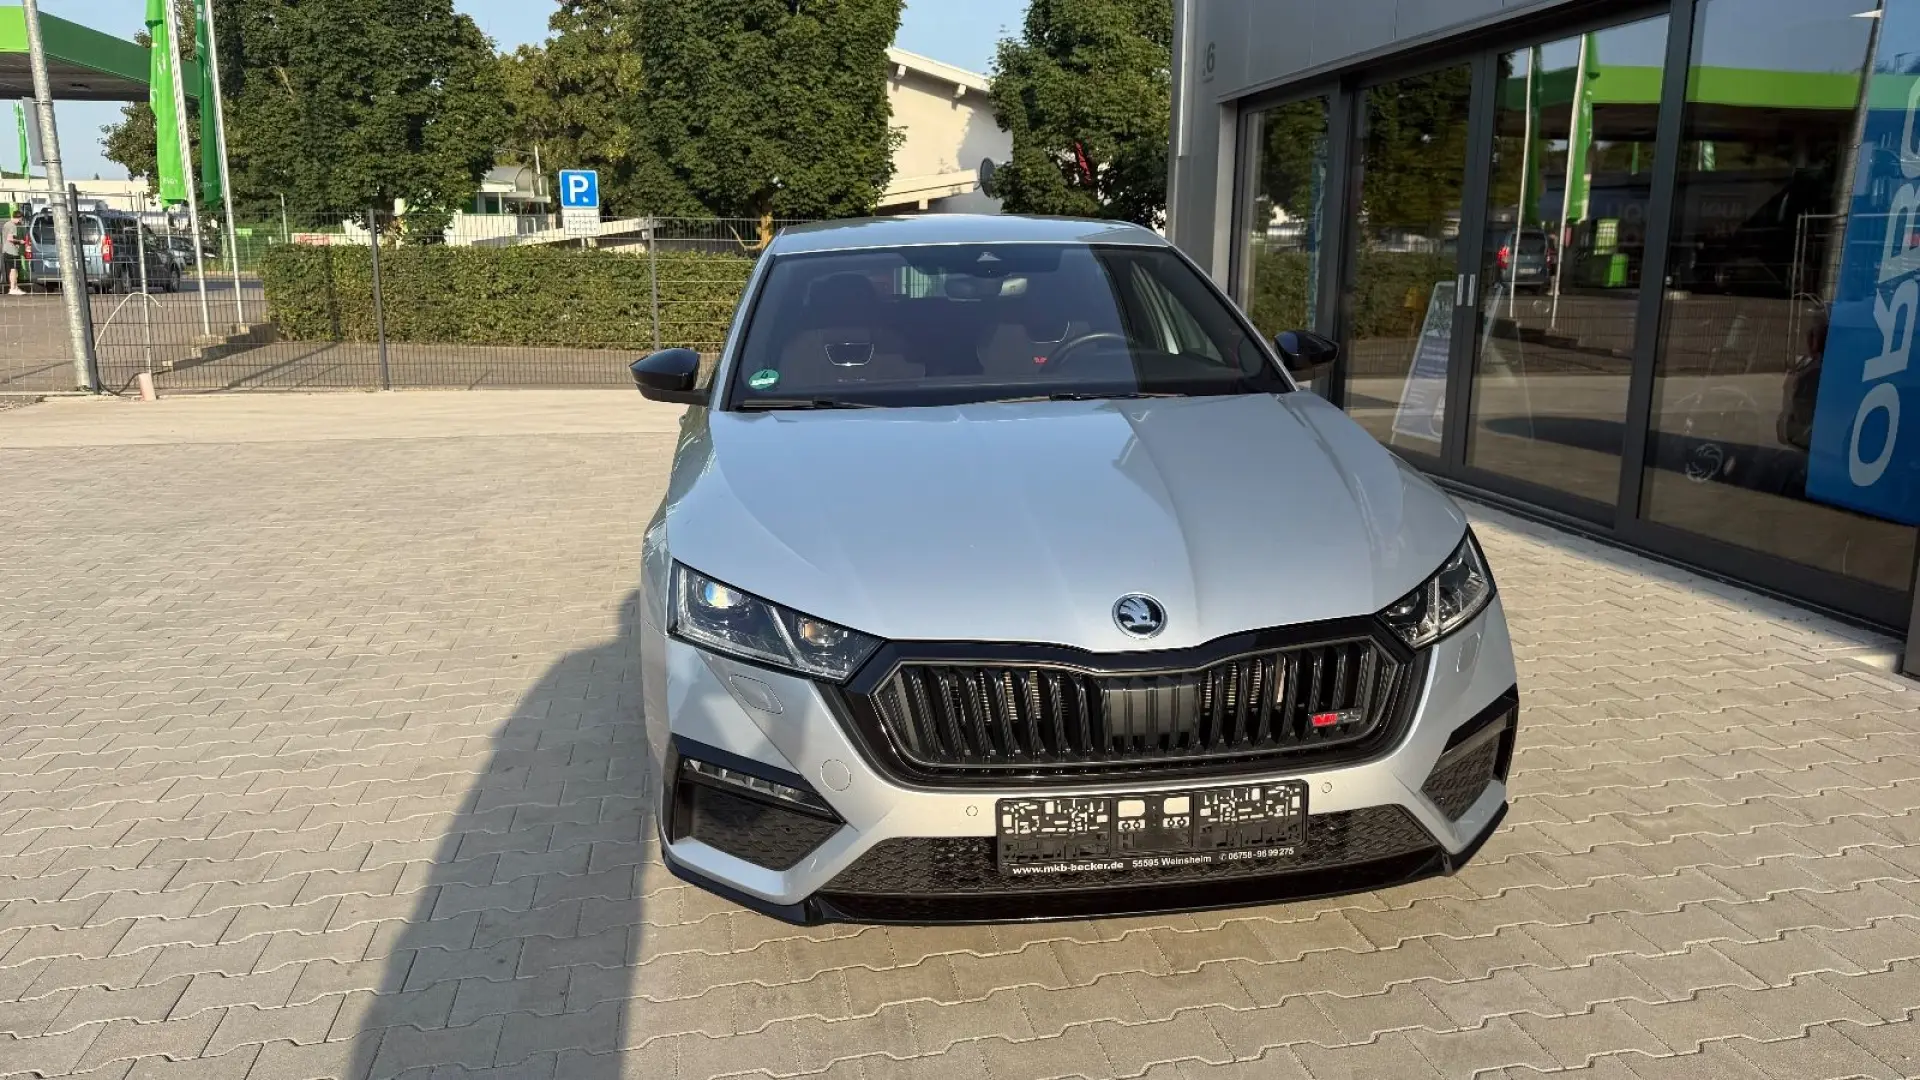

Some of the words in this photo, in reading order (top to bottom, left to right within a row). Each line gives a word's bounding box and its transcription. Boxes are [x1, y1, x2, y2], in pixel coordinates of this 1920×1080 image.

[569, 174, 588, 203] P
[1012, 861, 1124, 875] www.mkb-becker.de
[1161, 855, 1212, 866] Weinsheim
